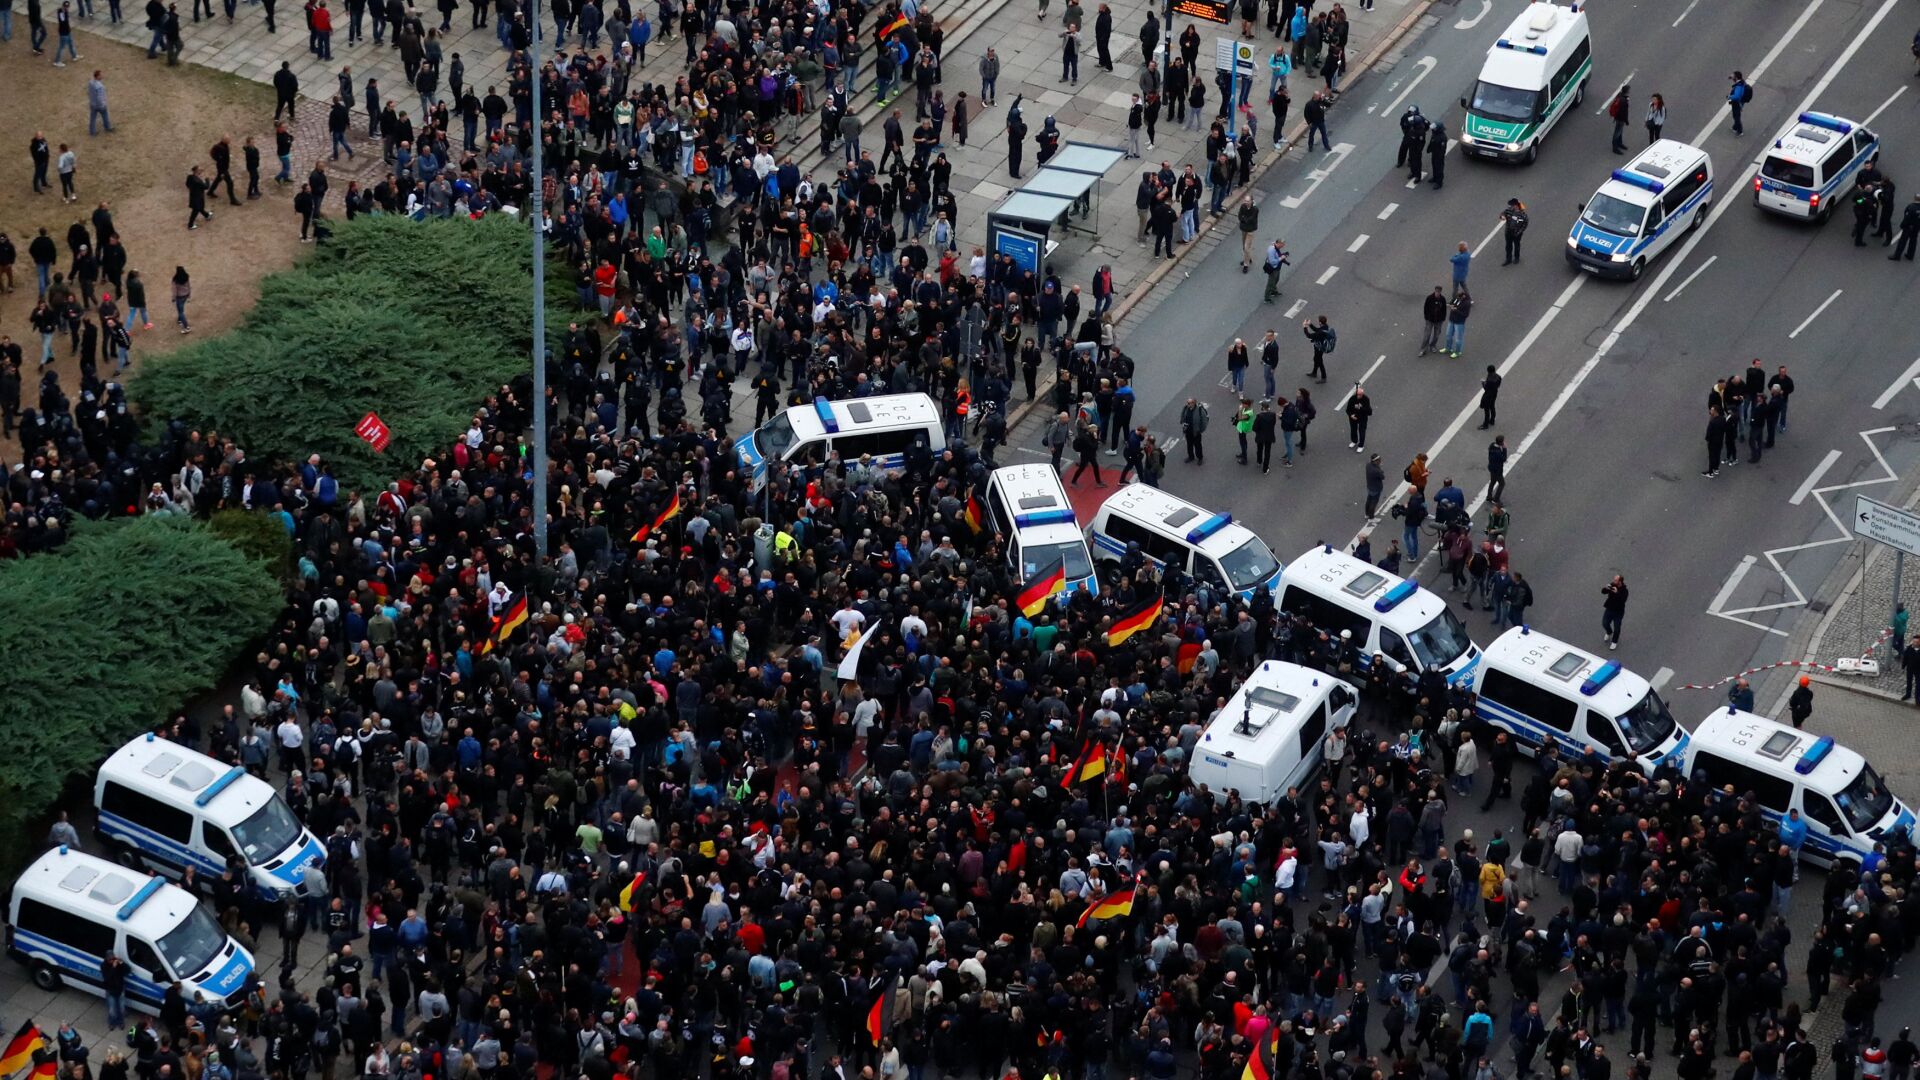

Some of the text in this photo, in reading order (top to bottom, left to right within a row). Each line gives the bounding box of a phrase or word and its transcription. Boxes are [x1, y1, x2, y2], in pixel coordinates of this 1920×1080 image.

[1478, 125, 1508, 137] POLIZEI
[1583, 234, 1613, 249] POLIZEI
[1320, 562, 1351, 583] 458
[1521, 645, 1551, 666] 460
[1732, 724, 1760, 746] 459
[220, 962, 247, 988] POLIZEI
